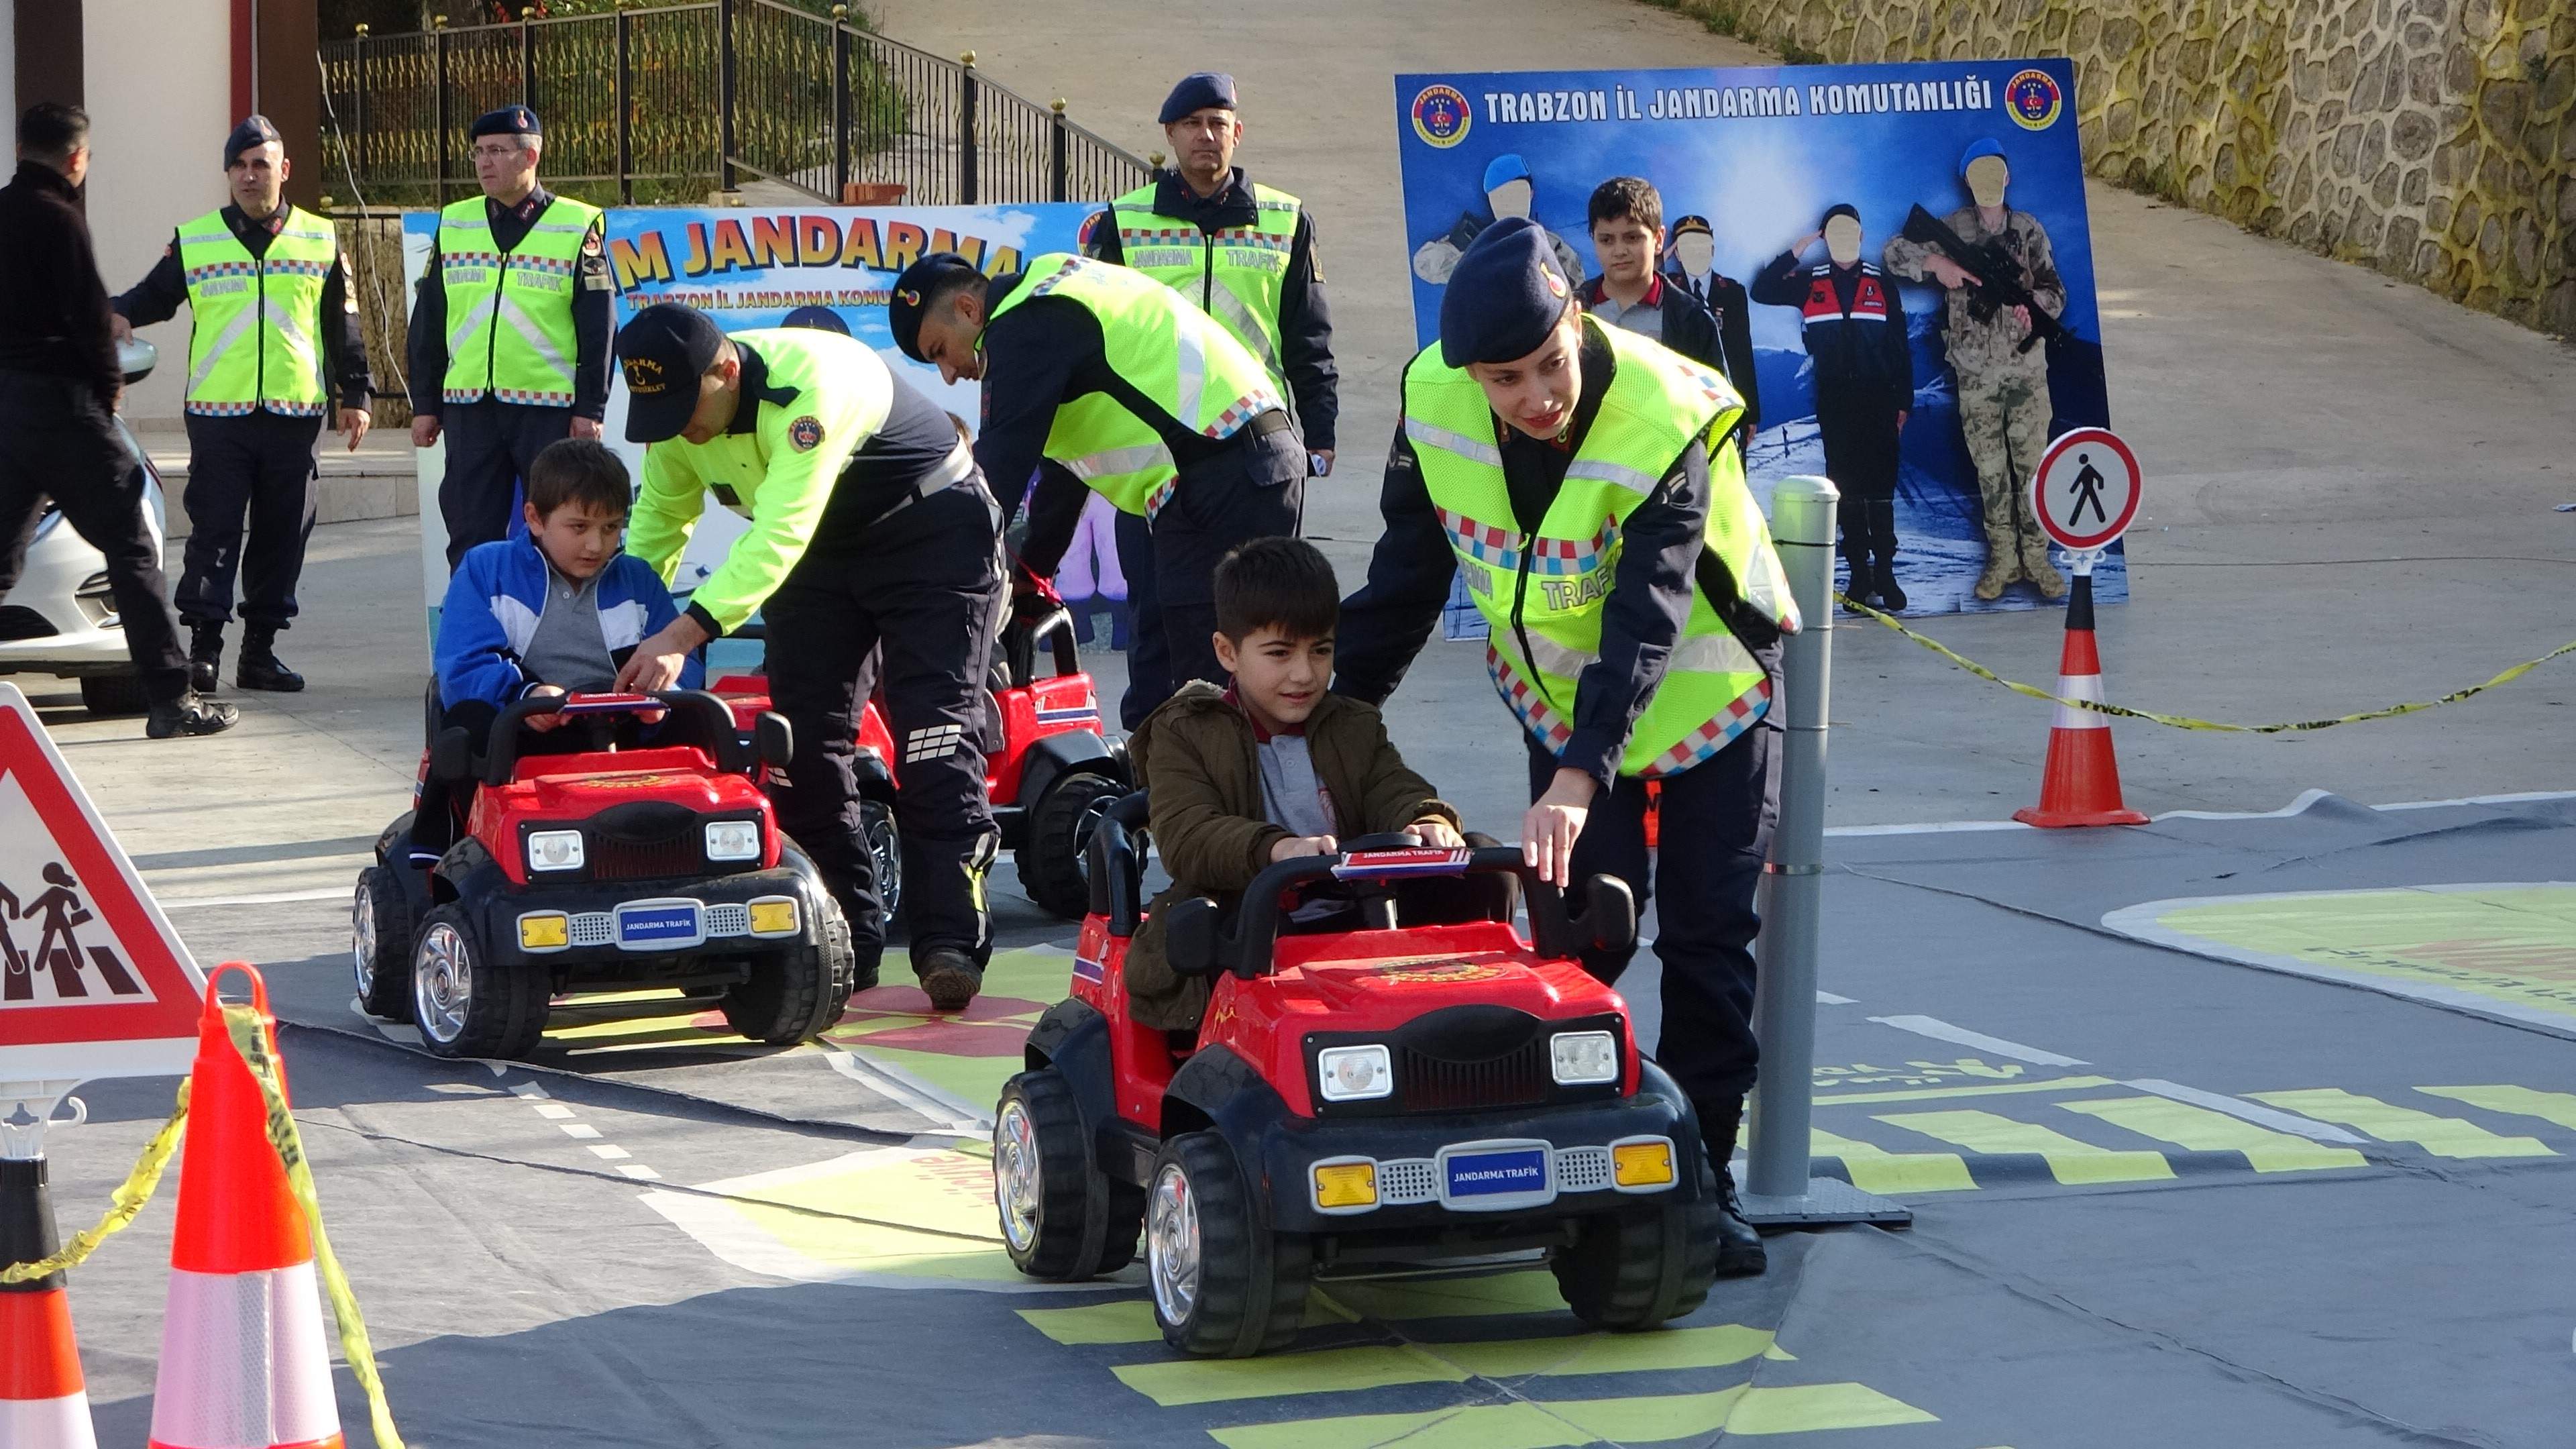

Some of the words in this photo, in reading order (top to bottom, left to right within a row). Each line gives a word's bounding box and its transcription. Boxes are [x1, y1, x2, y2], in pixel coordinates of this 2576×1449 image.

[2011, 72, 2053, 88] JANDARMA
[1419, 88, 1461, 105] JANDARMA
[1484, 91, 1608, 123] TRABZON
[1616, 85, 1642, 120] İL
[1649, 87, 1801, 119] JANDARMA
[1809, 74, 1992, 115] KOMUTANLIĞI
[683, 214, 1022, 280] JANDARMA
[716, 289, 733, 309] İL
[737, 290, 835, 308] JANDARMA
[838, 290, 893, 307] KOMU
[1363, 850, 1411, 859] JANDARMA
[625, 921, 664, 931] JANDARMA
[665, 918, 691, 928] TRAFİK
[1454, 1170, 1504, 1182] JANDARMA
[1506, 1166, 1539, 1178] TRAFİK
